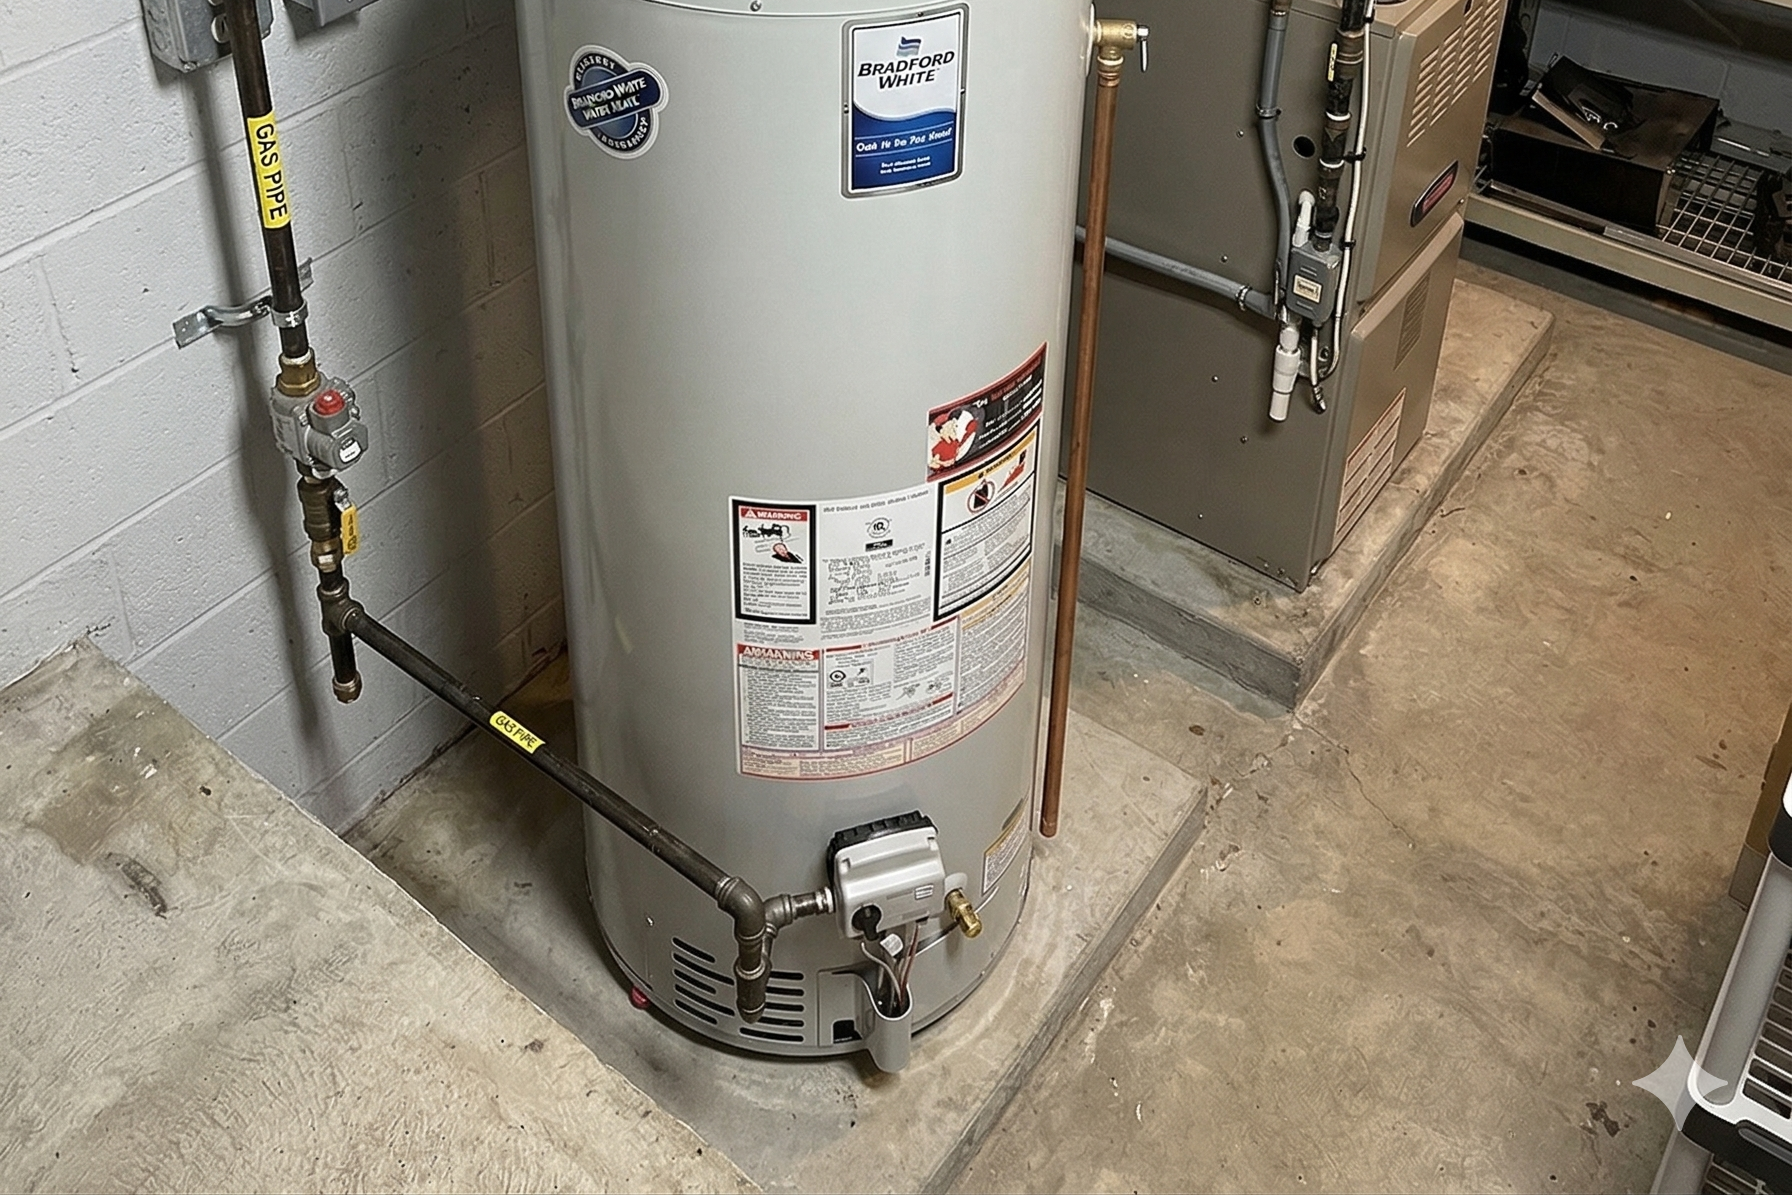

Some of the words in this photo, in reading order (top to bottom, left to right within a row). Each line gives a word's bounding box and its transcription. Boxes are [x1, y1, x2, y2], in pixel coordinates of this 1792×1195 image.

[858, 51, 955, 77] BRADFORD
[879, 69, 936, 90] WHITE
[256, 123, 278, 167] GAS
[264, 170, 287, 220] PIPE
